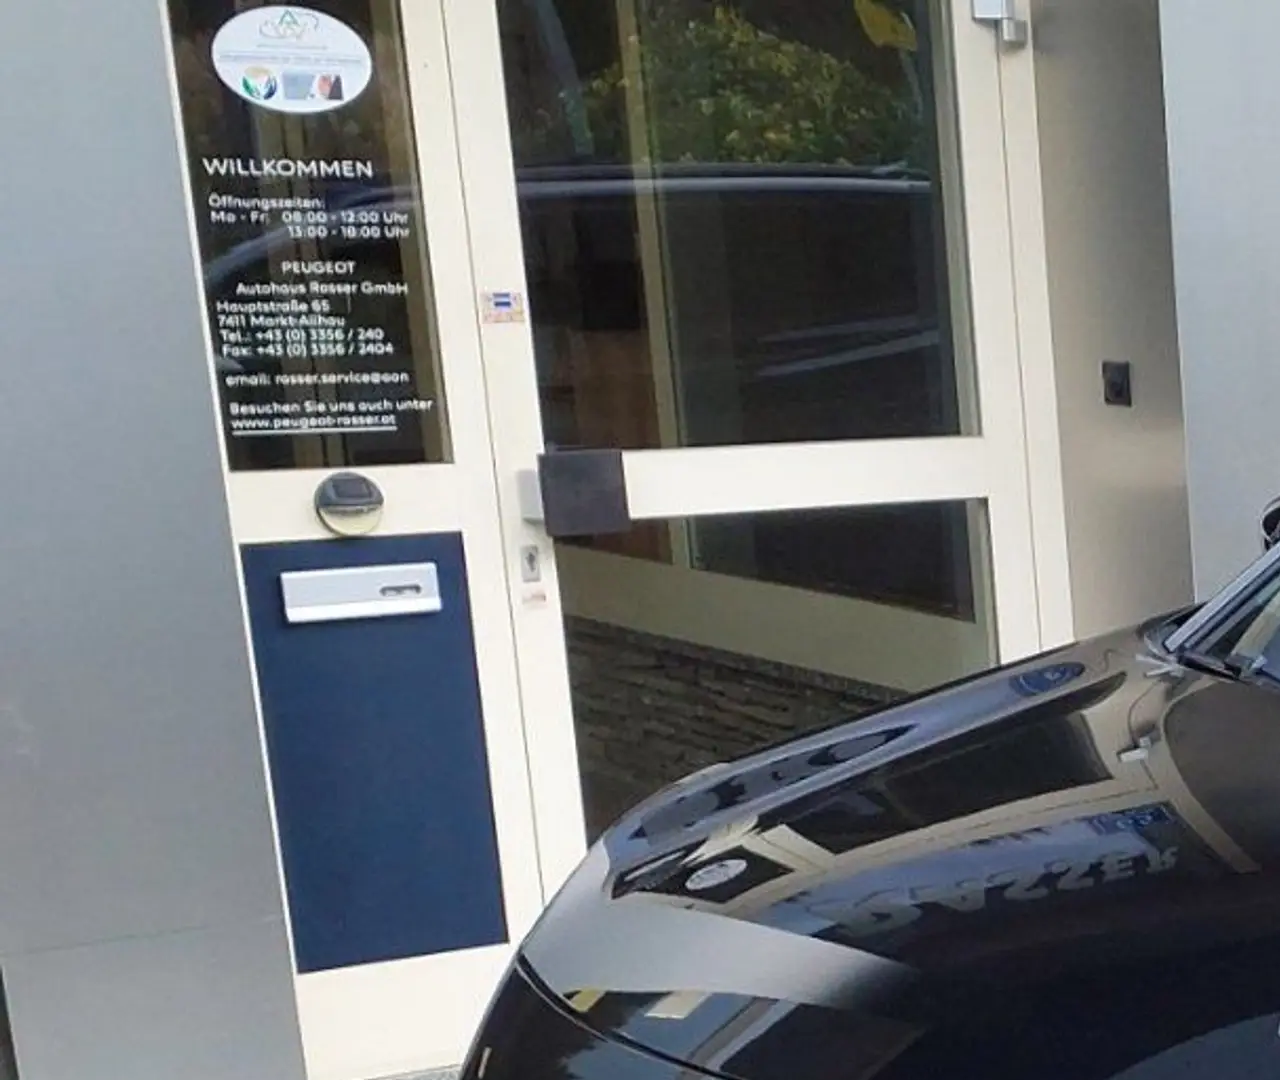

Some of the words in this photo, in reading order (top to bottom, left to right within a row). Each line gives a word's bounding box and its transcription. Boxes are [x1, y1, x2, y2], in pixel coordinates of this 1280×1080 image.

[202, 157, 373, 178] WILLKOMMEN
[208, 192, 325, 210] Öffnungszeiten:
[210, 211, 236, 223] Mo
[384, 211, 409, 223] Uhr
[384, 225, 410, 237] Uhr
[281, 260, 356, 273] PEUGEOT
[236, 282, 306, 296] Autohaus
[310, 281, 357, 294] Rasser
[360, 281, 408, 295] GmbH
[216, 300, 308, 314] Hauptstraße
[217, 315, 247, 327] 7411
[250, 314, 346, 327] Markt-Allhau
[255, 329, 283, 341] +43
[286, 328, 305, 343] (0)
[309, 328, 345, 340] 3356
[357, 327, 385, 340] 240
[256, 343, 283, 355] +43
[286, 342, 307, 357] (0)
[310, 342, 345, 355] 3356
[225, 373, 270, 386] email:
[229, 401, 300, 416] Besuchen
[304, 400, 326, 412] Sie
[329, 400, 355, 412] uns
[358, 398, 393, 411] auch
[396, 398, 433, 411] unter
